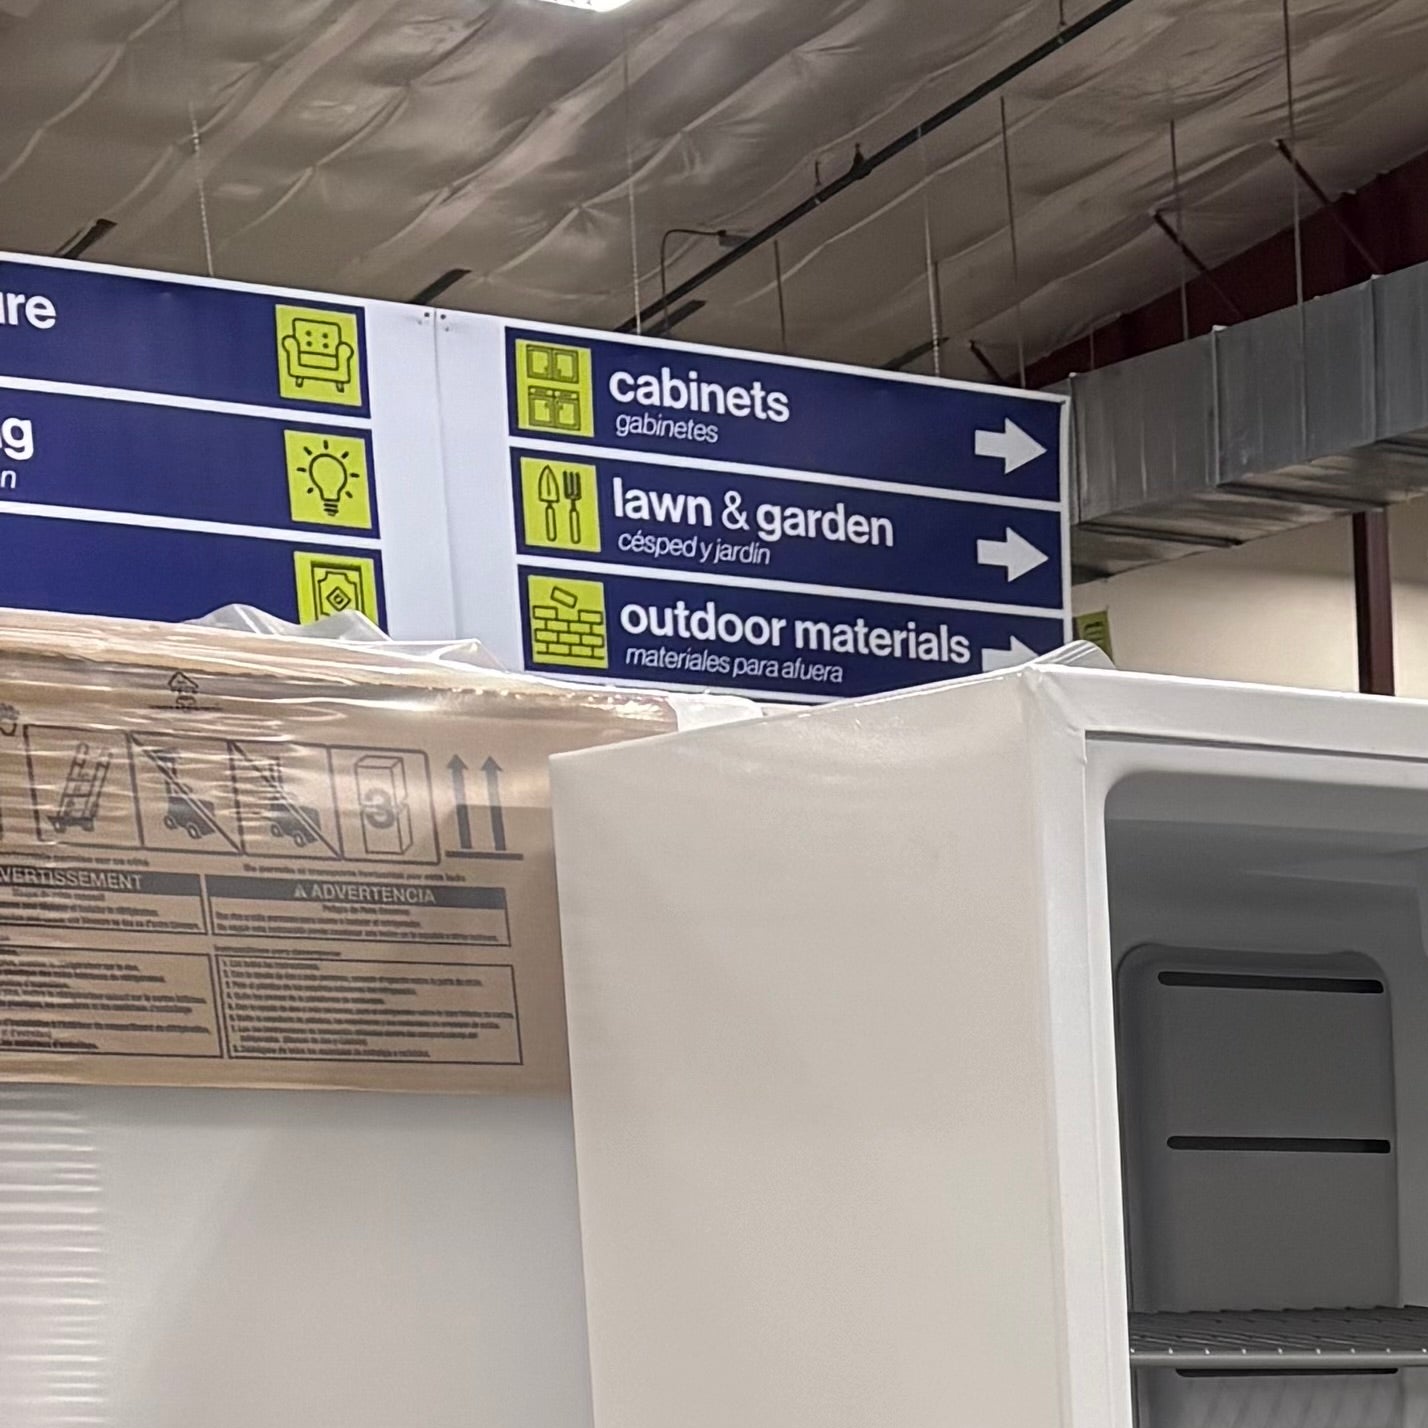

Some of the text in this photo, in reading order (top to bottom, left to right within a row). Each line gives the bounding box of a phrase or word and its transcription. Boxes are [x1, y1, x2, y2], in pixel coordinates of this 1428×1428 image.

[608, 367, 790, 423] cabinets
[0, 417, 34, 461] g
[615, 413, 719, 443] gabinetes
[612, 477, 894, 547] lawn & garden
[618, 530, 698, 558] césped
[699, 541, 715, 564] y
[620, 601, 972, 664] outdoor materials
[732, 656, 778, 678] para
[781, 658, 843, 683] afuera
[311, 883, 436, 904] ADVERTENCIA
